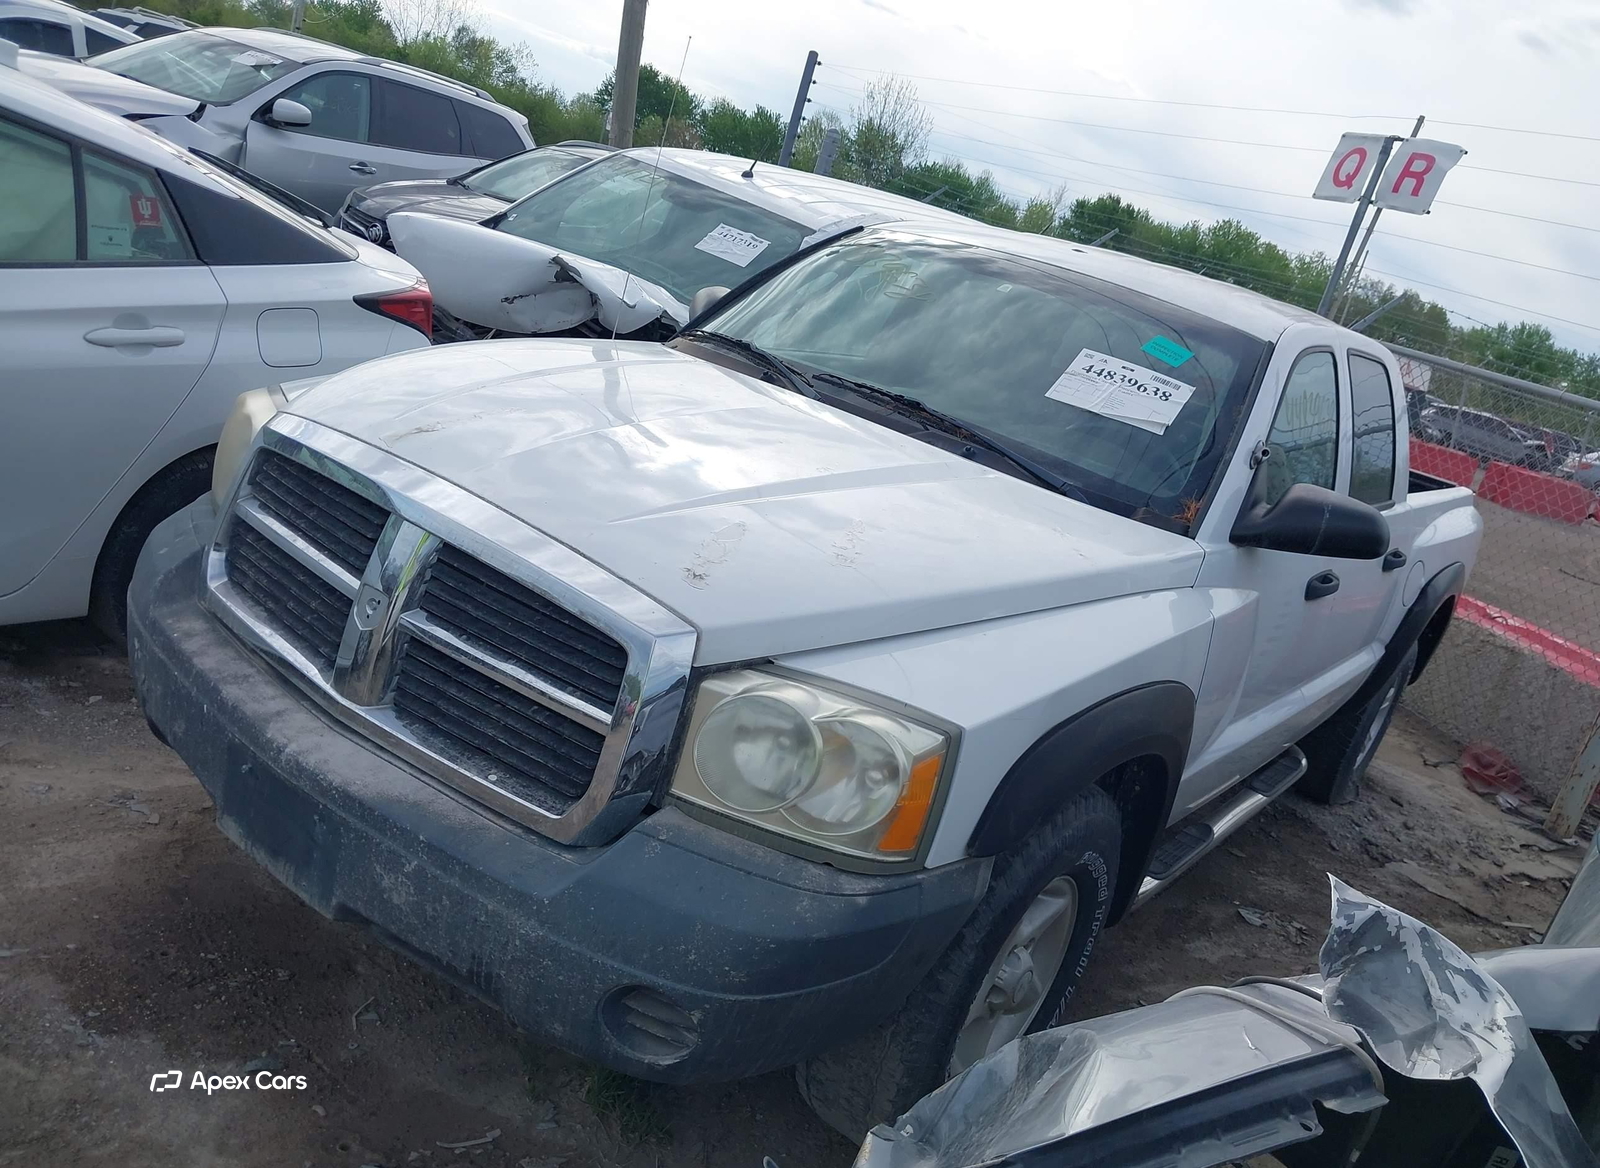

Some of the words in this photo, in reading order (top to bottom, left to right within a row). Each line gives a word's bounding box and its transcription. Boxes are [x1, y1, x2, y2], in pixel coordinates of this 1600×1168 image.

[1332, 146, 1368, 190] Q
[1391, 152, 1436, 197] R
[1081, 363, 1174, 402] 44839638
